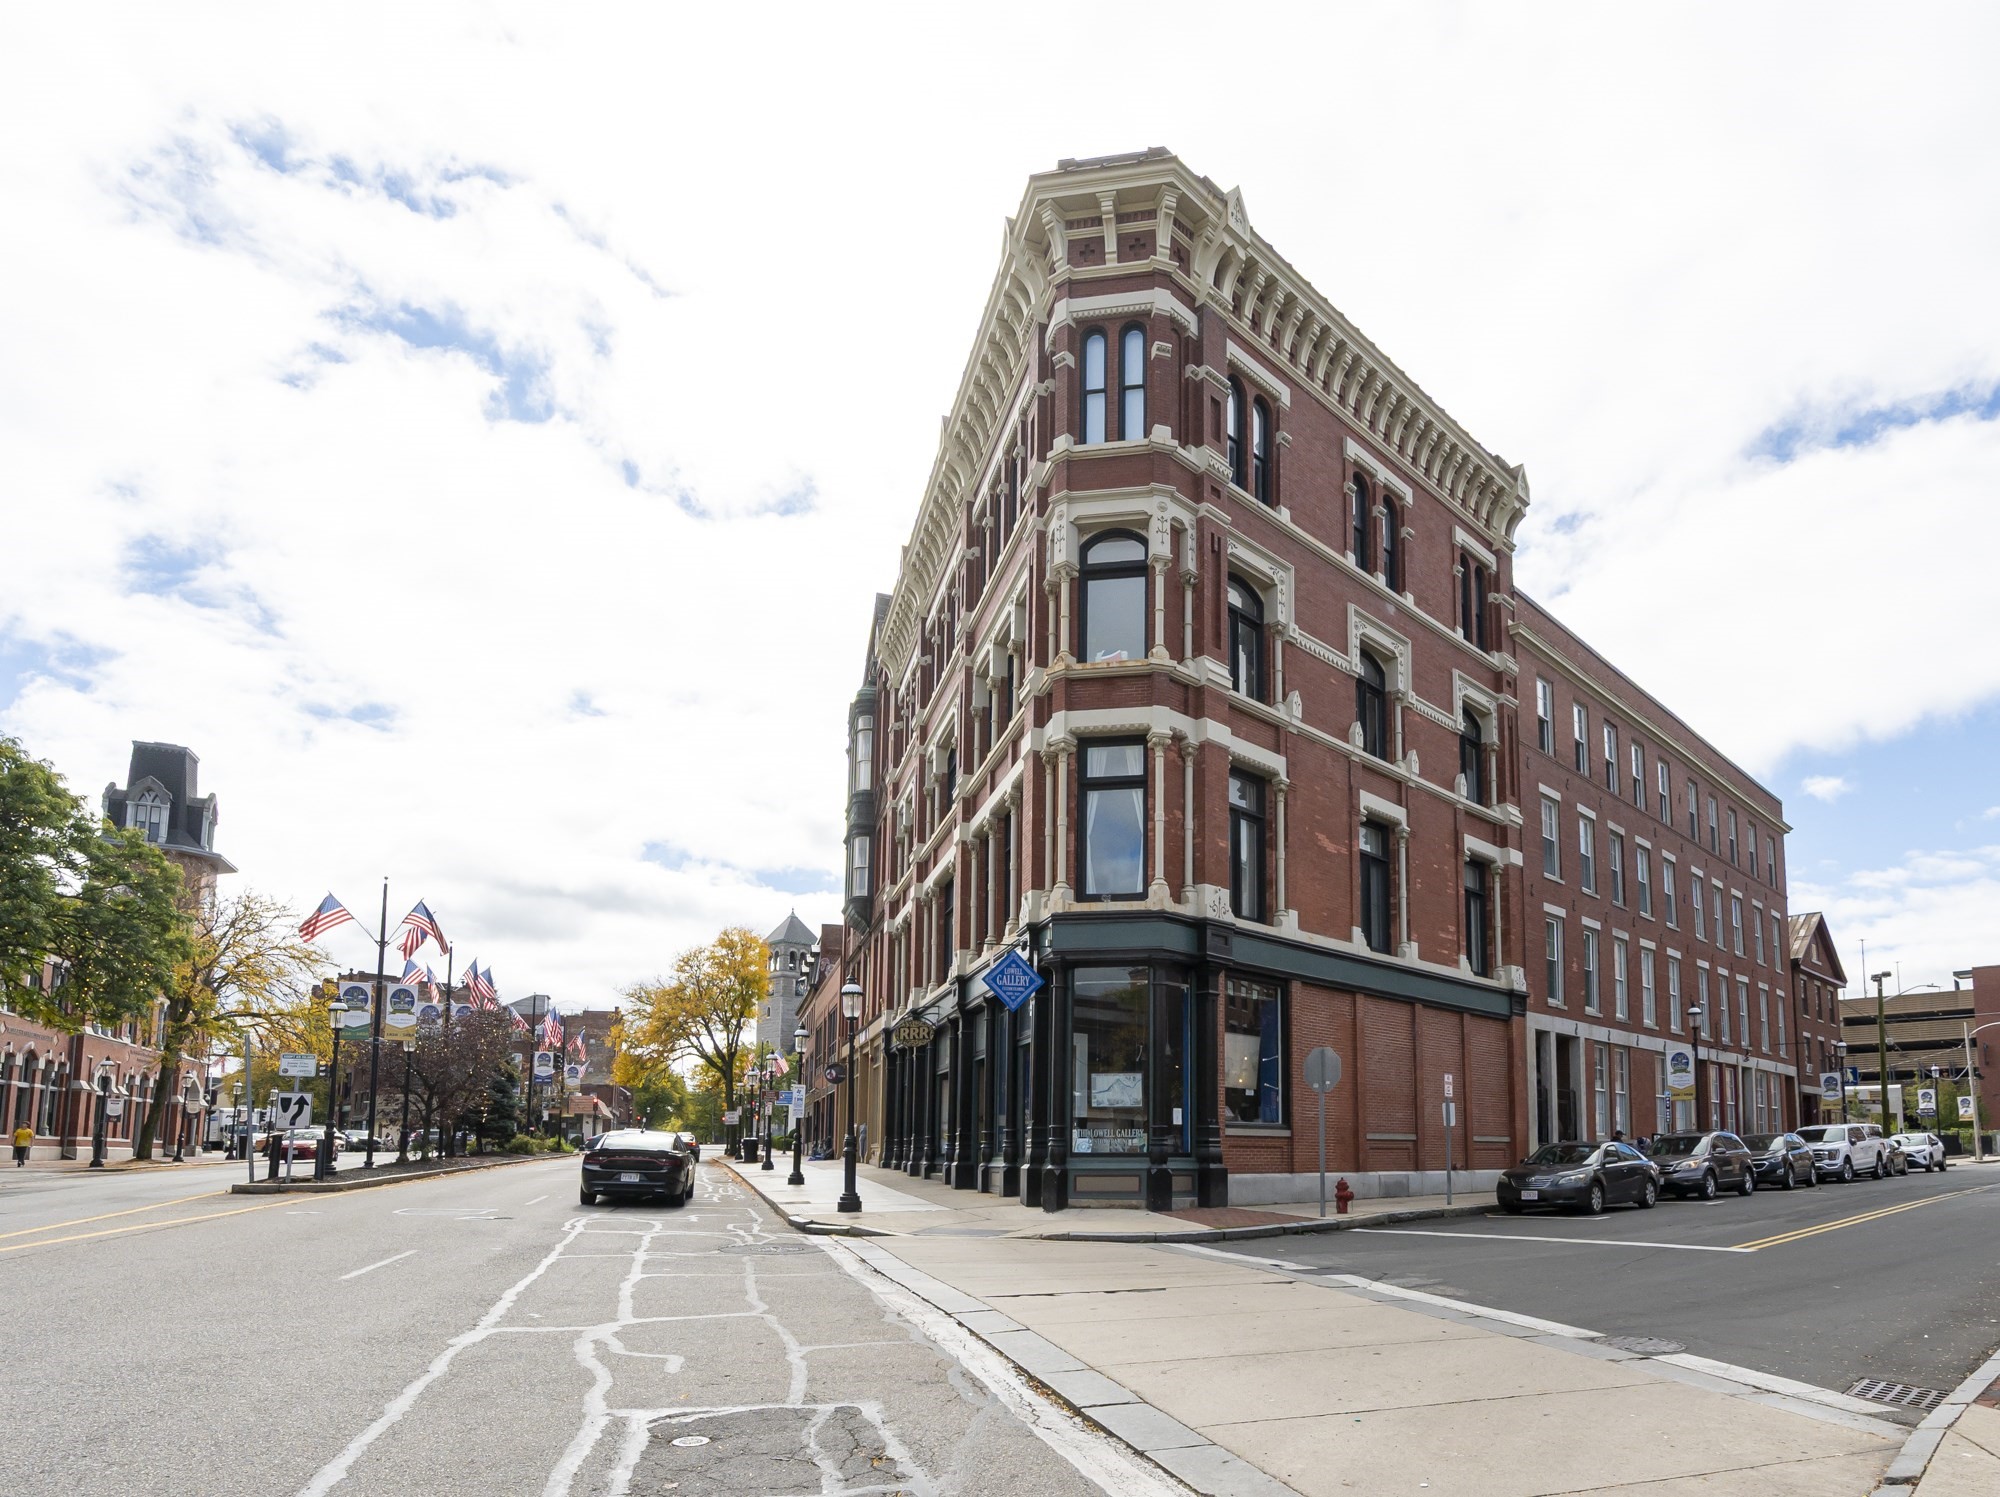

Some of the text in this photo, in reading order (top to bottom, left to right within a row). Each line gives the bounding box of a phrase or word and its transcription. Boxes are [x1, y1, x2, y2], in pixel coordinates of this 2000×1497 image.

[1004, 967, 1023, 975] LOWELL
[996, 974, 1030, 986] GALLERY
[900, 1026, 929, 1040] RRR
[1090, 1129, 1115, 1138] LOWELL
[1116, 1129, 1144, 1137] GALLERY
